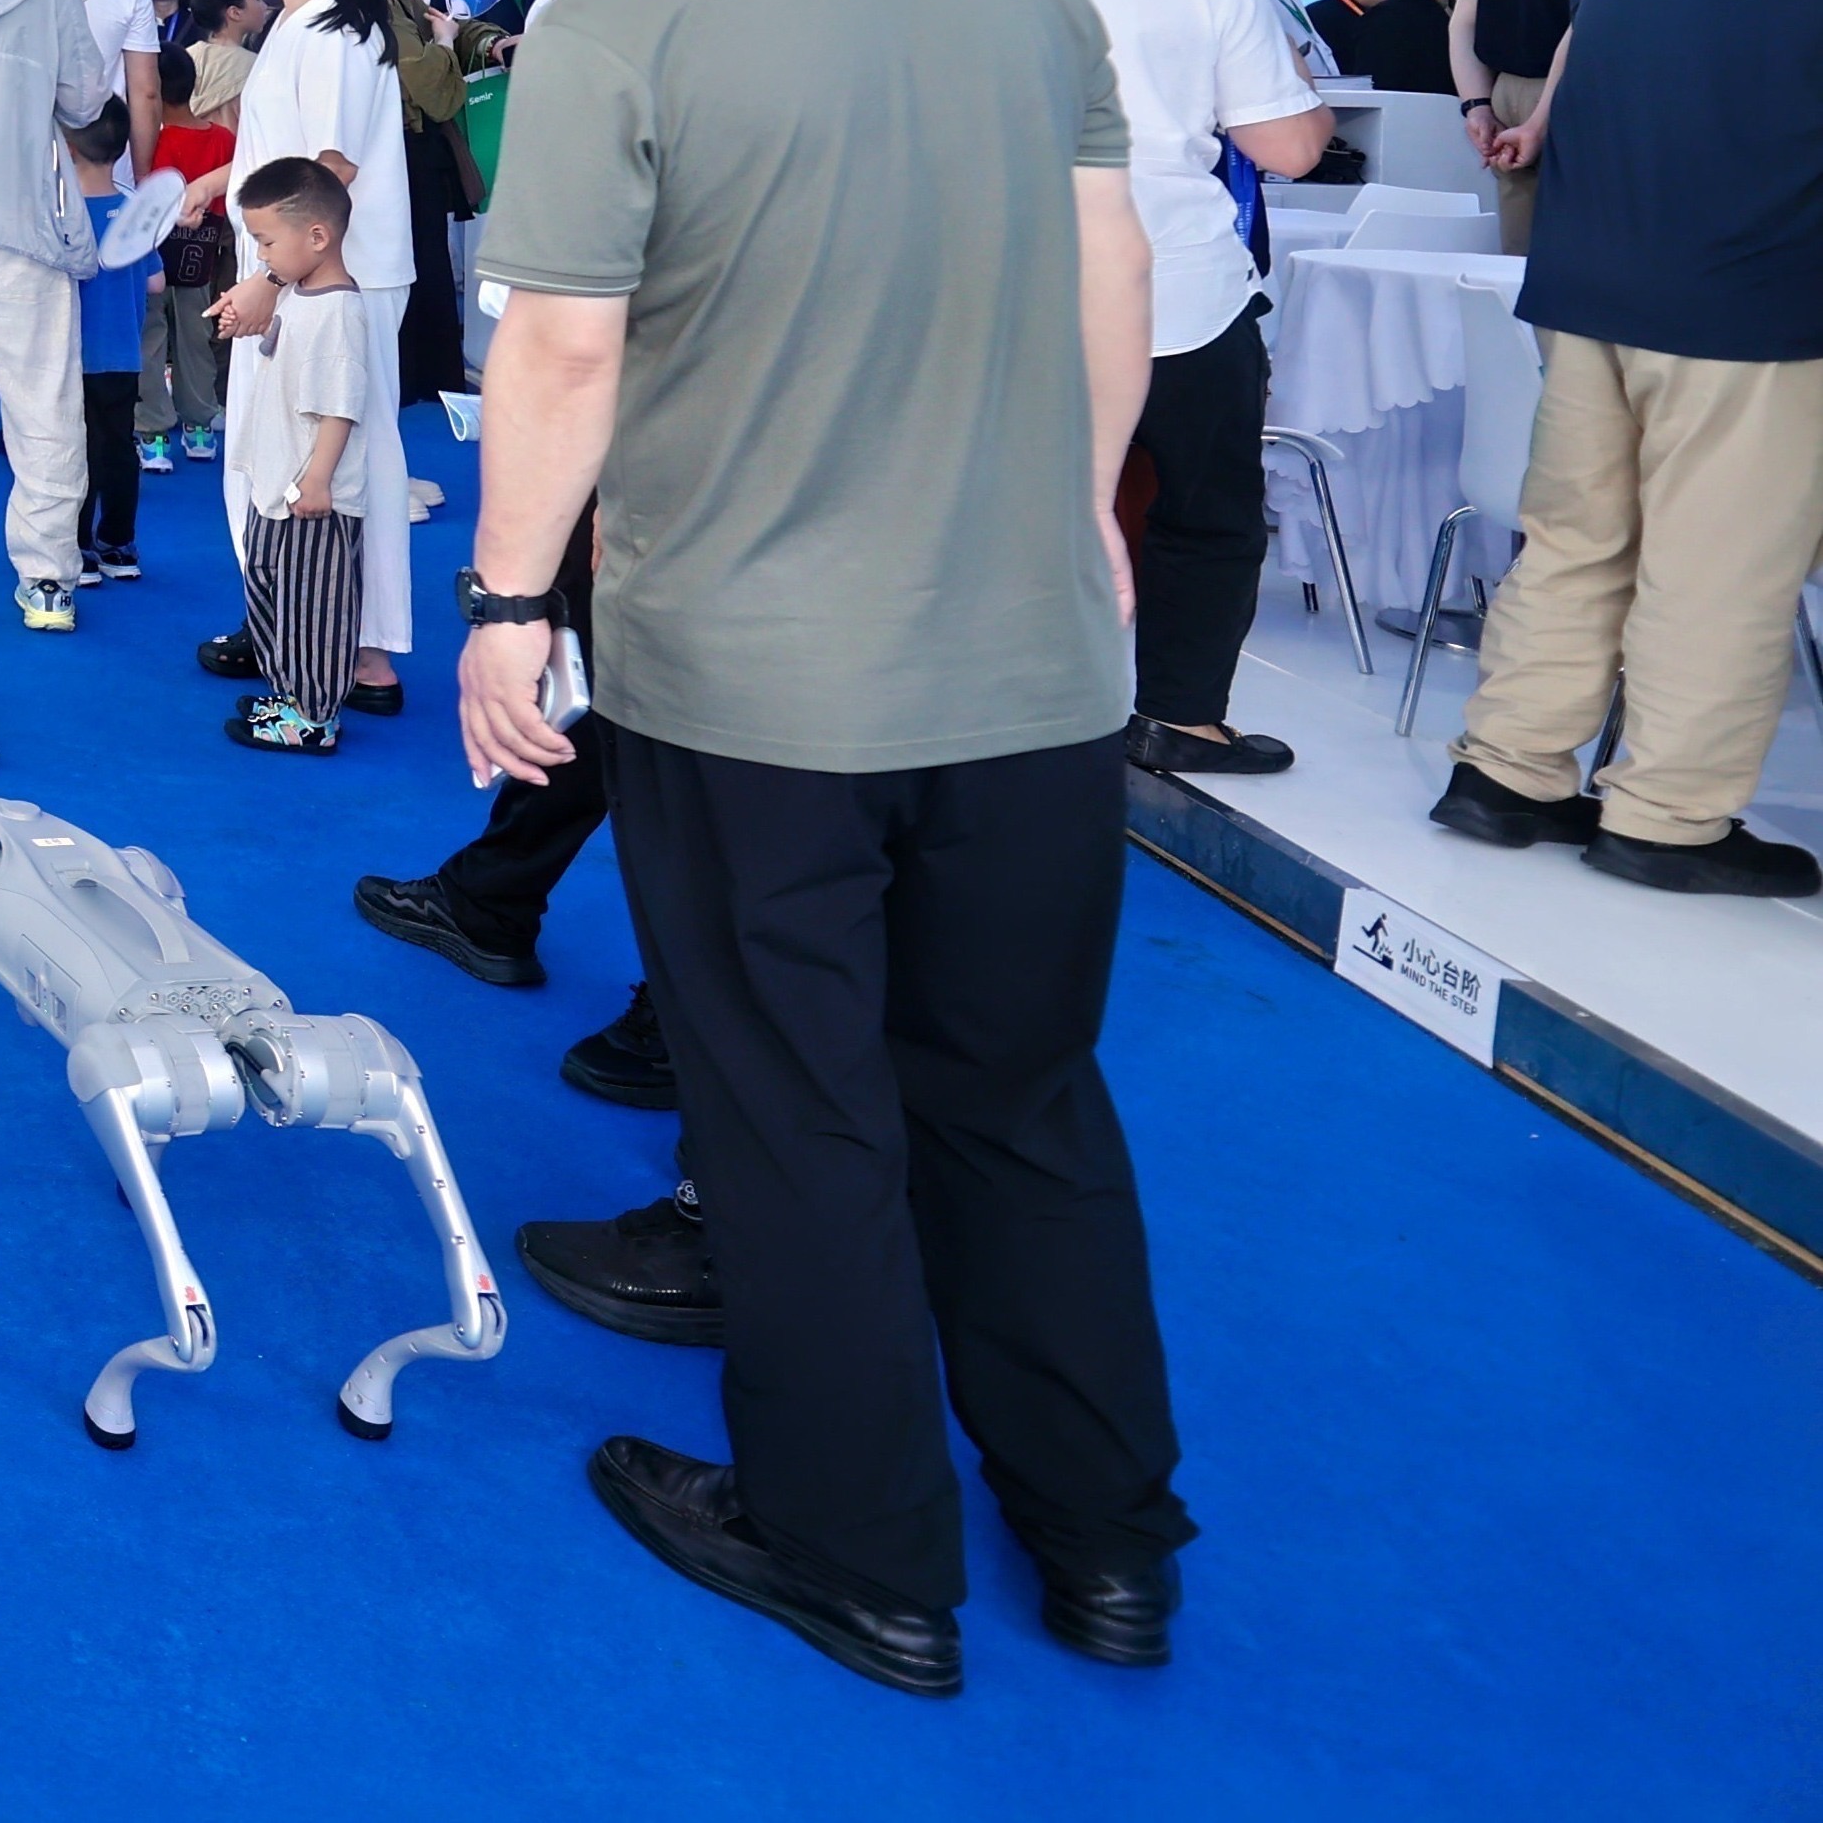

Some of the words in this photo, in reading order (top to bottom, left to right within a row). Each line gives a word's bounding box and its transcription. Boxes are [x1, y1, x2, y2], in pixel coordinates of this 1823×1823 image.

[178, 244, 204, 282] 6
[1400, 963, 1427, 987] MIND
[1429, 979, 1450, 1001] THE
[1451, 994, 1478, 1016] STEP
[1402, 938, 1481, 1002] 小心台阶
